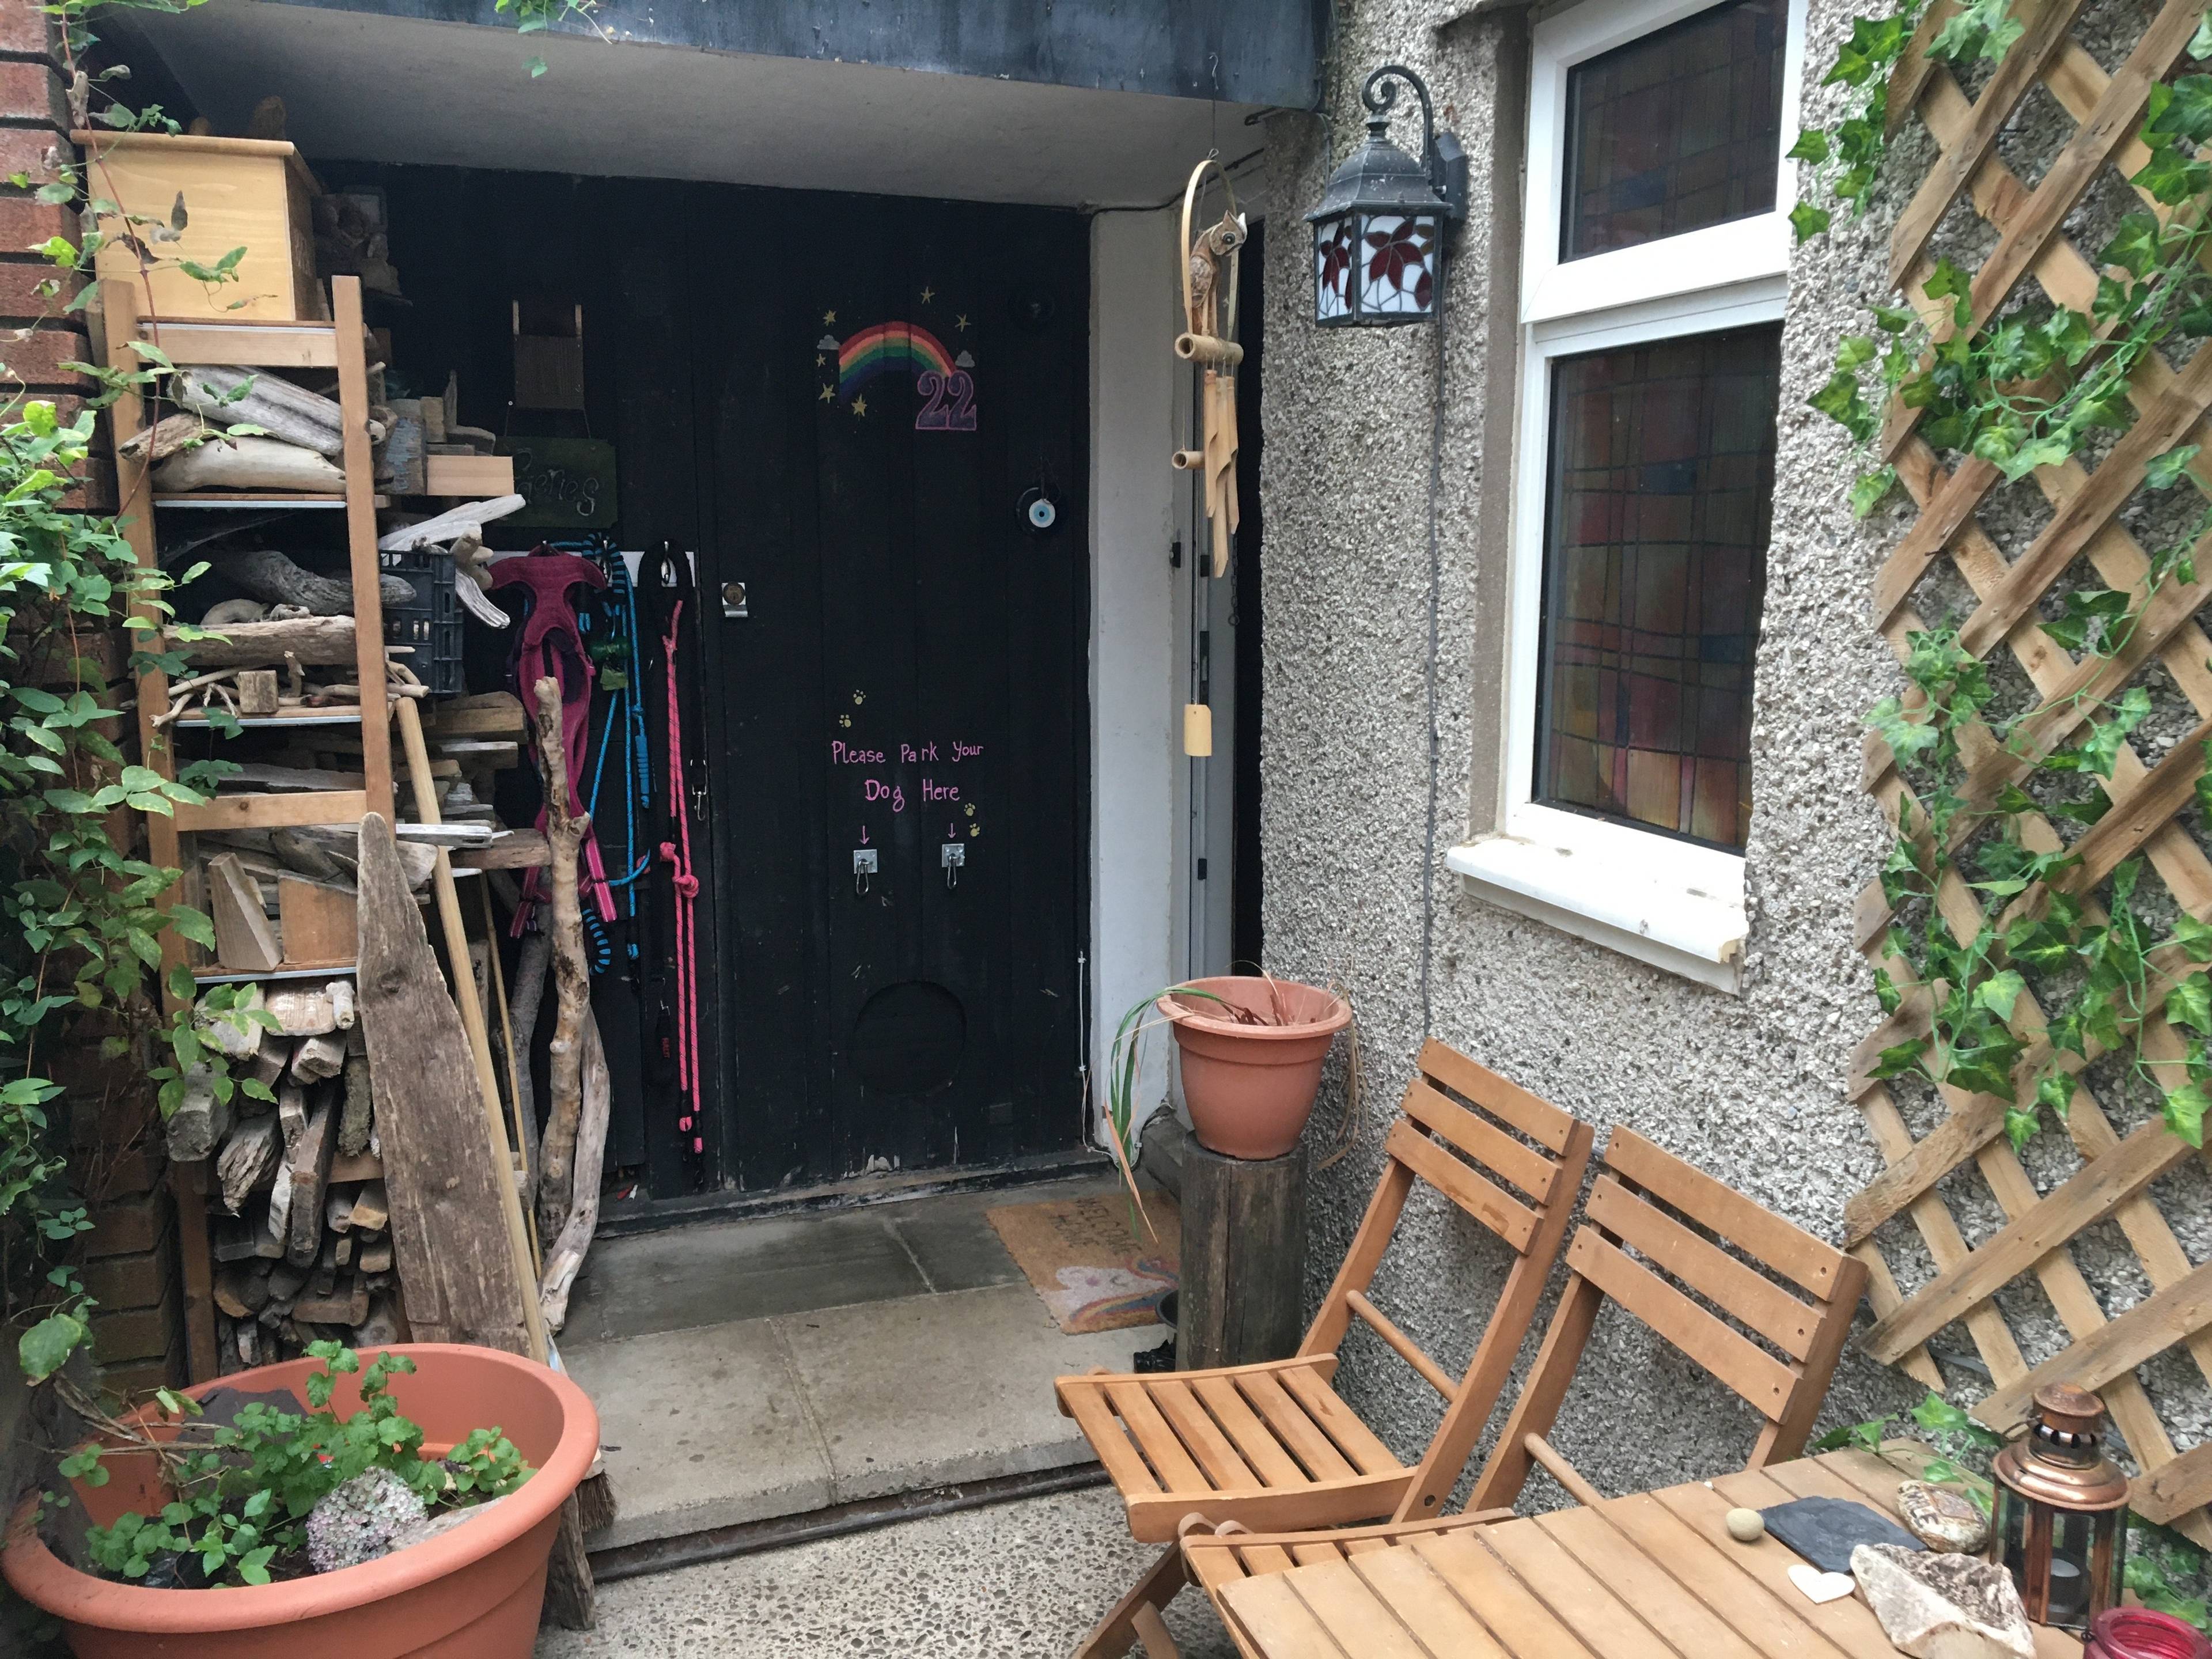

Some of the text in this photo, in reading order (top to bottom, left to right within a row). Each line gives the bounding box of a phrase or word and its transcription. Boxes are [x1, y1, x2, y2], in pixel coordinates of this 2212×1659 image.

[915, 370, 977, 431] 22
[831, 740, 886, 764] Please
[900, 741, 940, 763] Park
[864, 778, 960, 813] Dog Here
